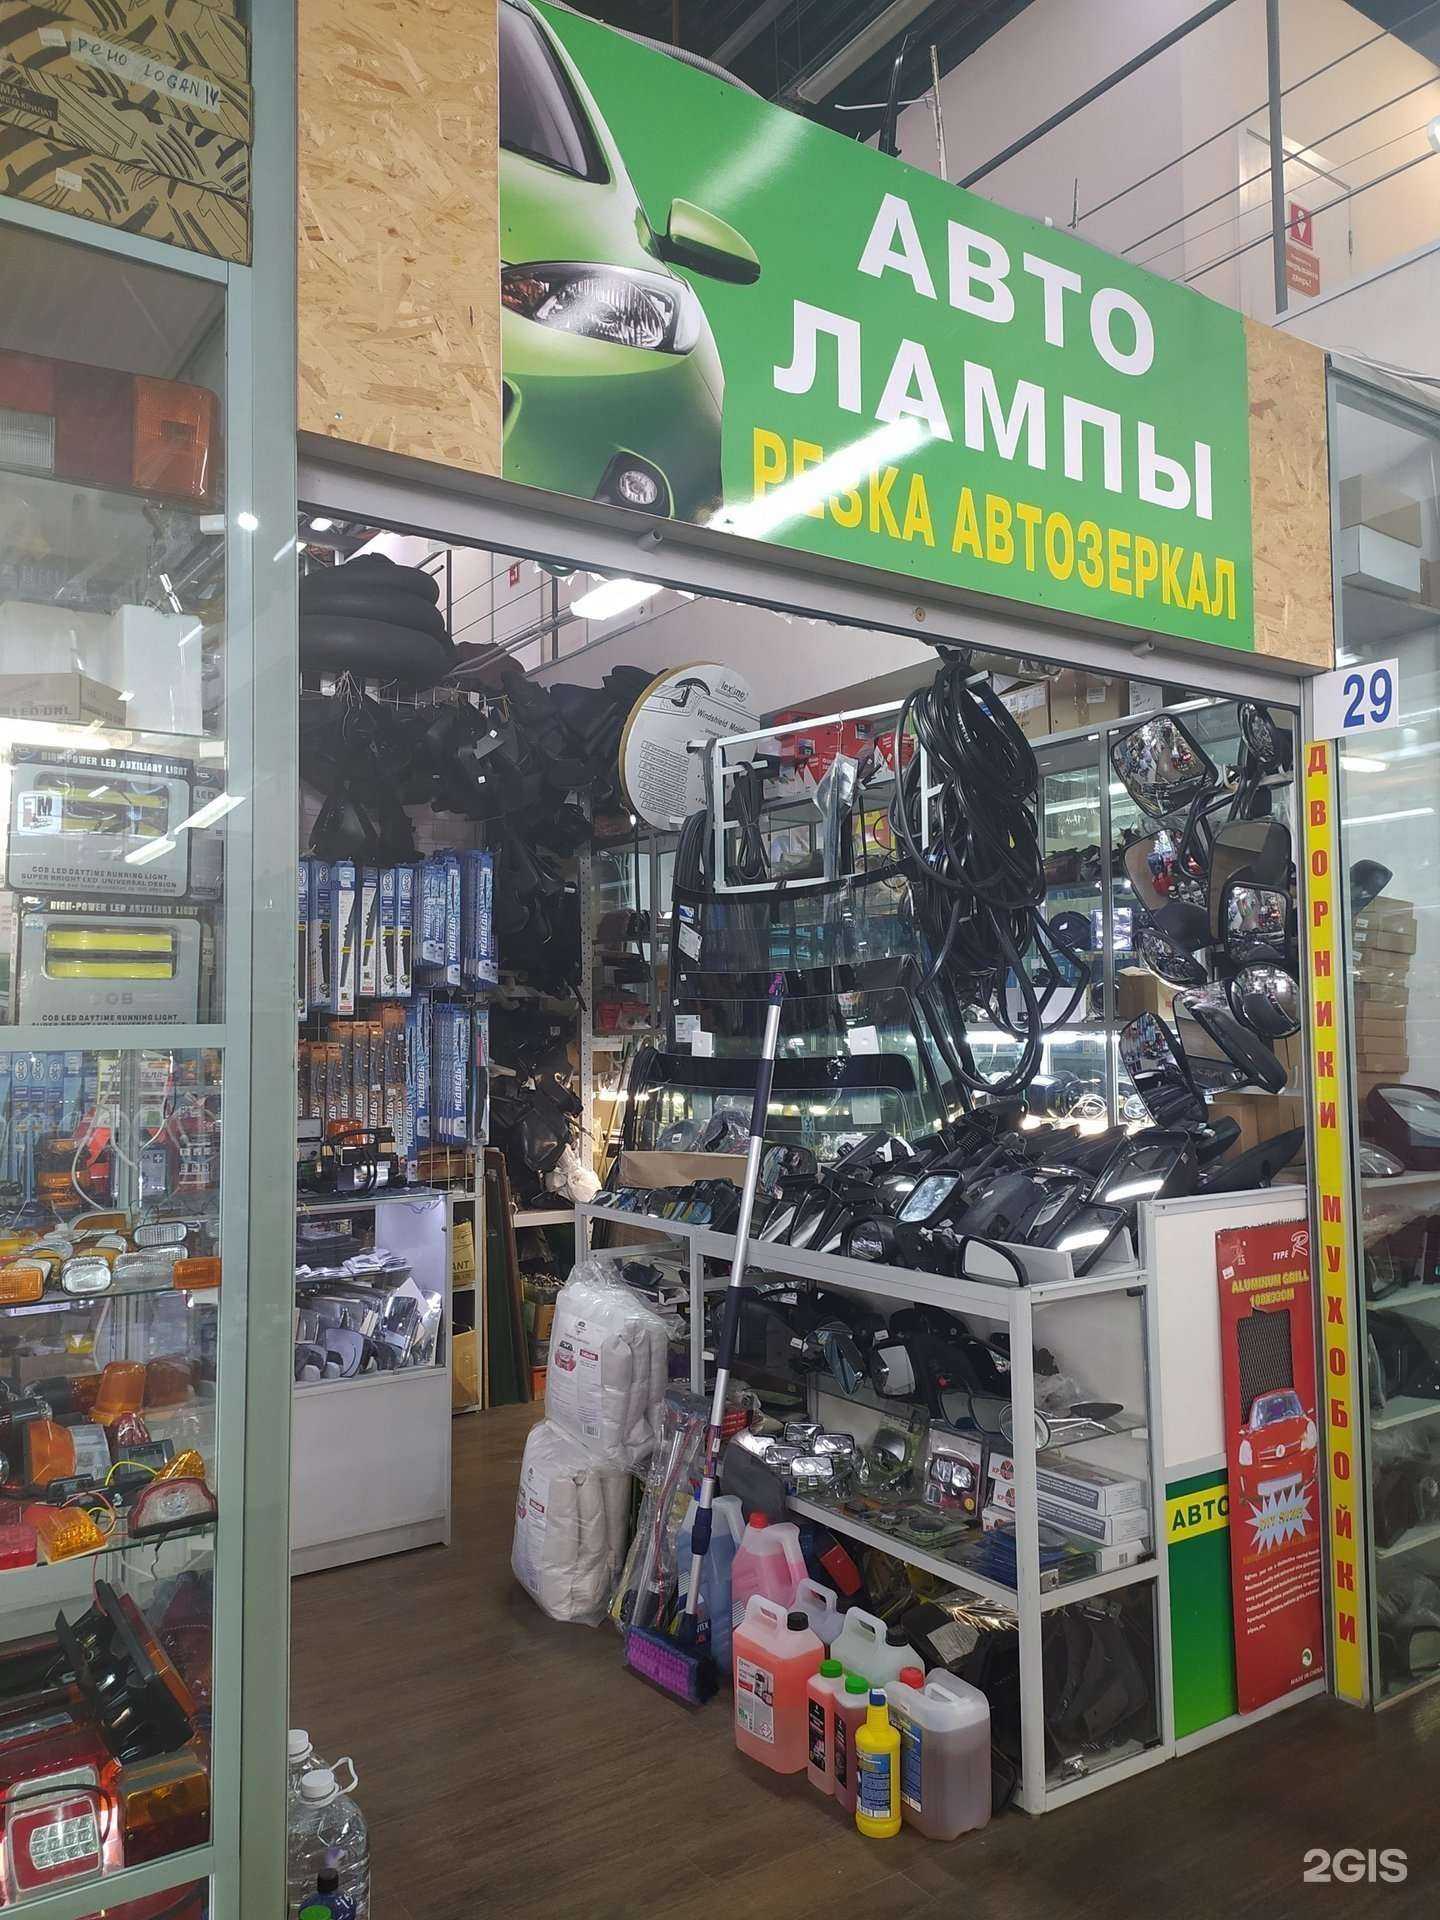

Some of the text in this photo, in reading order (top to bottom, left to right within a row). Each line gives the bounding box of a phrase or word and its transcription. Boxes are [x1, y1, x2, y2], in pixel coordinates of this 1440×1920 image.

[143, 63, 200, 97] LOGAN
[857, 193, 1155, 376] АВТО
[773, 299, 1214, 520] ЛАМПЫ
[952, 486, 1236, 620] АВТОЗЕРКАЛ
[697, 709, 728, 728] Windshield
[1342, 668, 1392, 729] 29
[100, 757, 117, 768] LED
[165, 764, 188, 776] LIGHT
[50, 901, 107, 913] HIGH-POWER
[109, 903, 126, 913] LED
[448, 916, 457, 962] МЕДВЕДЬ
[479, 911, 489, 957] МЕДВЕДЬ
[1307, 744, 1337, 1130] ДВОРНИКИ
[78, 1014, 115, 1022] DAYTIME
[116, 1014, 152, 1022] RUNNING
[153, 1014, 178, 1022] LIGHT
[417, 1065, 426, 1110] МЕДВЕДЬ
[453, 1066, 463, 1112] МЕДВЕДЬ
[1272, 1230, 1309, 1261] TYPE R
[1231, 1269, 1310, 1294] ALUMINUM GRILL
[1322, 1194, 1357, 1645] МУХОБОЙКИ
[1171, 1494, 1230, 1531] АВТО
